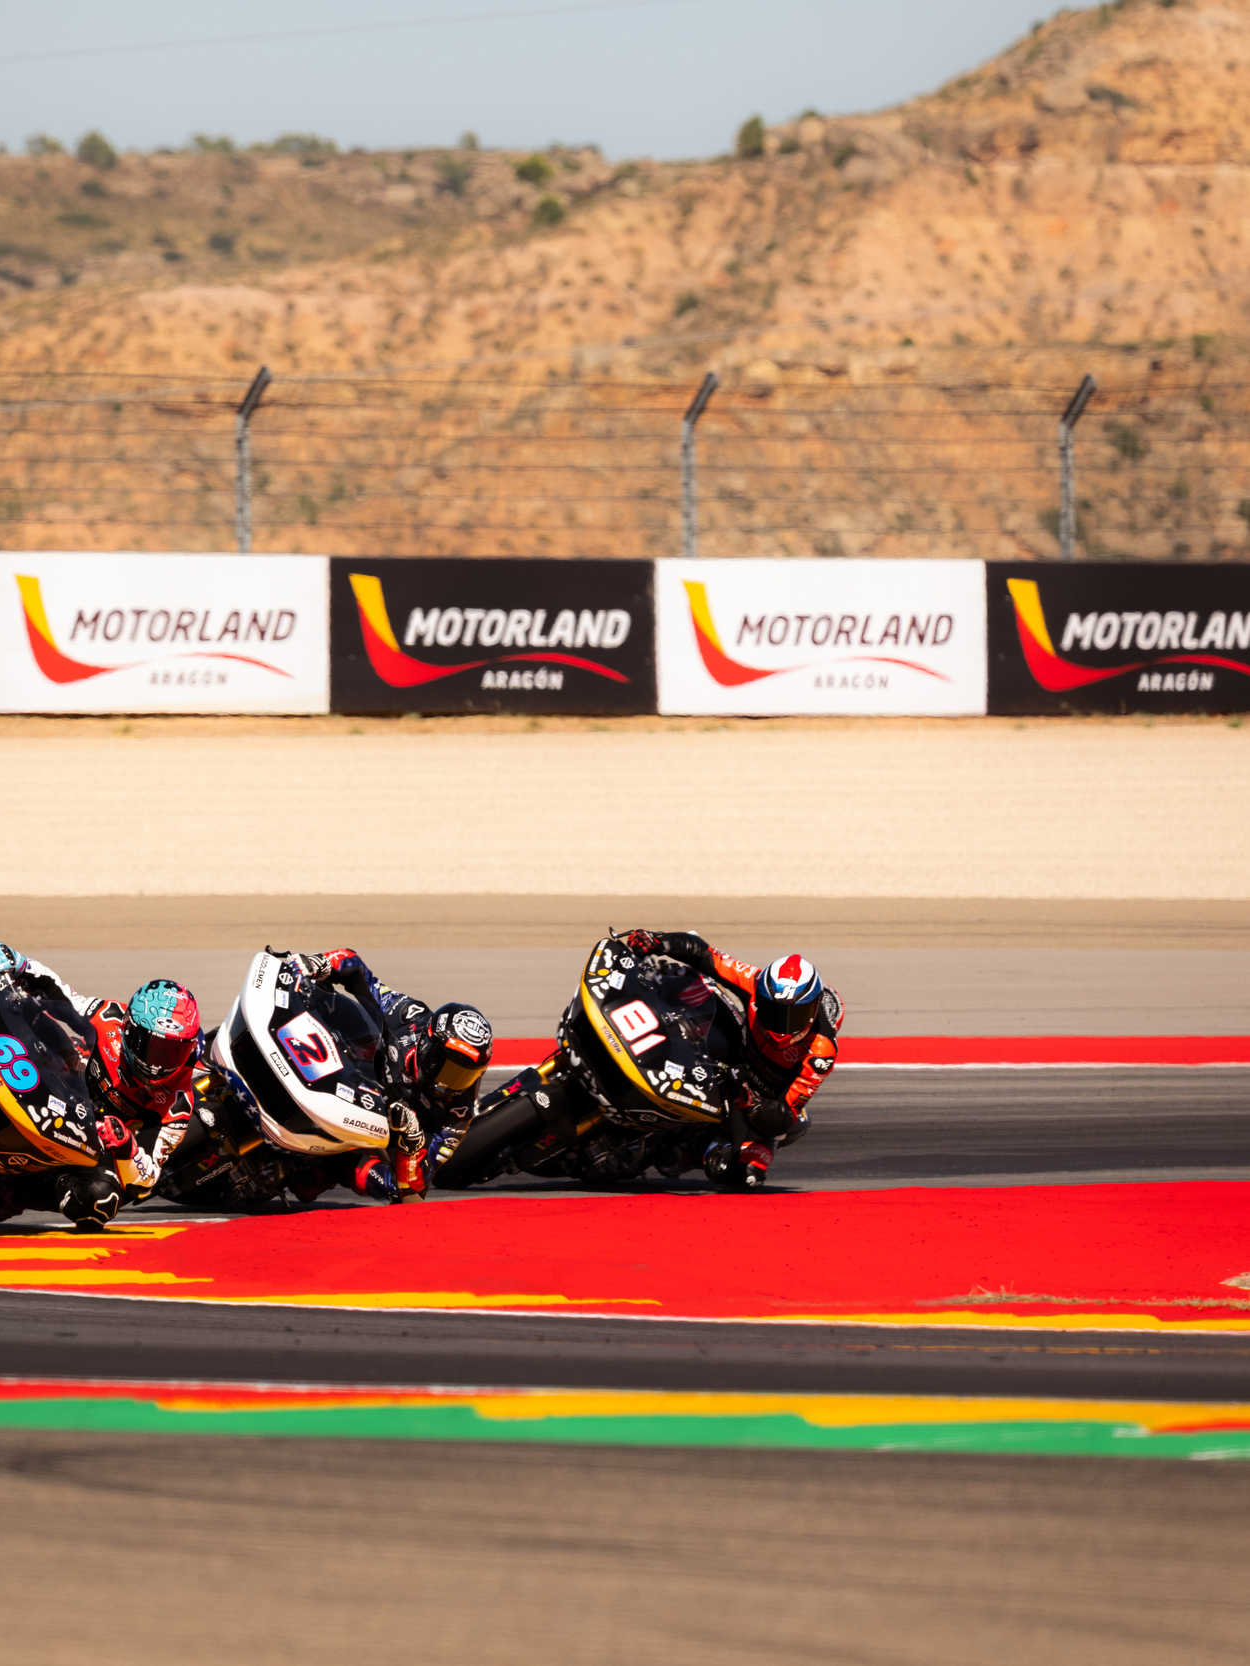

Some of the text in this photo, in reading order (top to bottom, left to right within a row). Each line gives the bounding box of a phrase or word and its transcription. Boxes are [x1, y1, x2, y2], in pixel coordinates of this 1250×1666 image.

[70, 609, 297, 642] MOTORLAND
[404, 608, 631, 648] MOTORLAND
[736, 613, 954, 647] MOTORLAND
[1061, 610, 1250, 651] MOTORLAN
[149, 668, 228, 687] ARAGÓN
[482, 669, 564, 690] ARAGÓN
[813, 671, 890, 690] ARAGÓN
[1137, 670, 1214, 691] ARAGÓN
[609, 999, 667, 1057] 81
[283, 1031, 329, 1067] 2
[270, 1051, 290, 1077] MOTUL
[342, 1117, 389, 1136] SADDLEMEN
